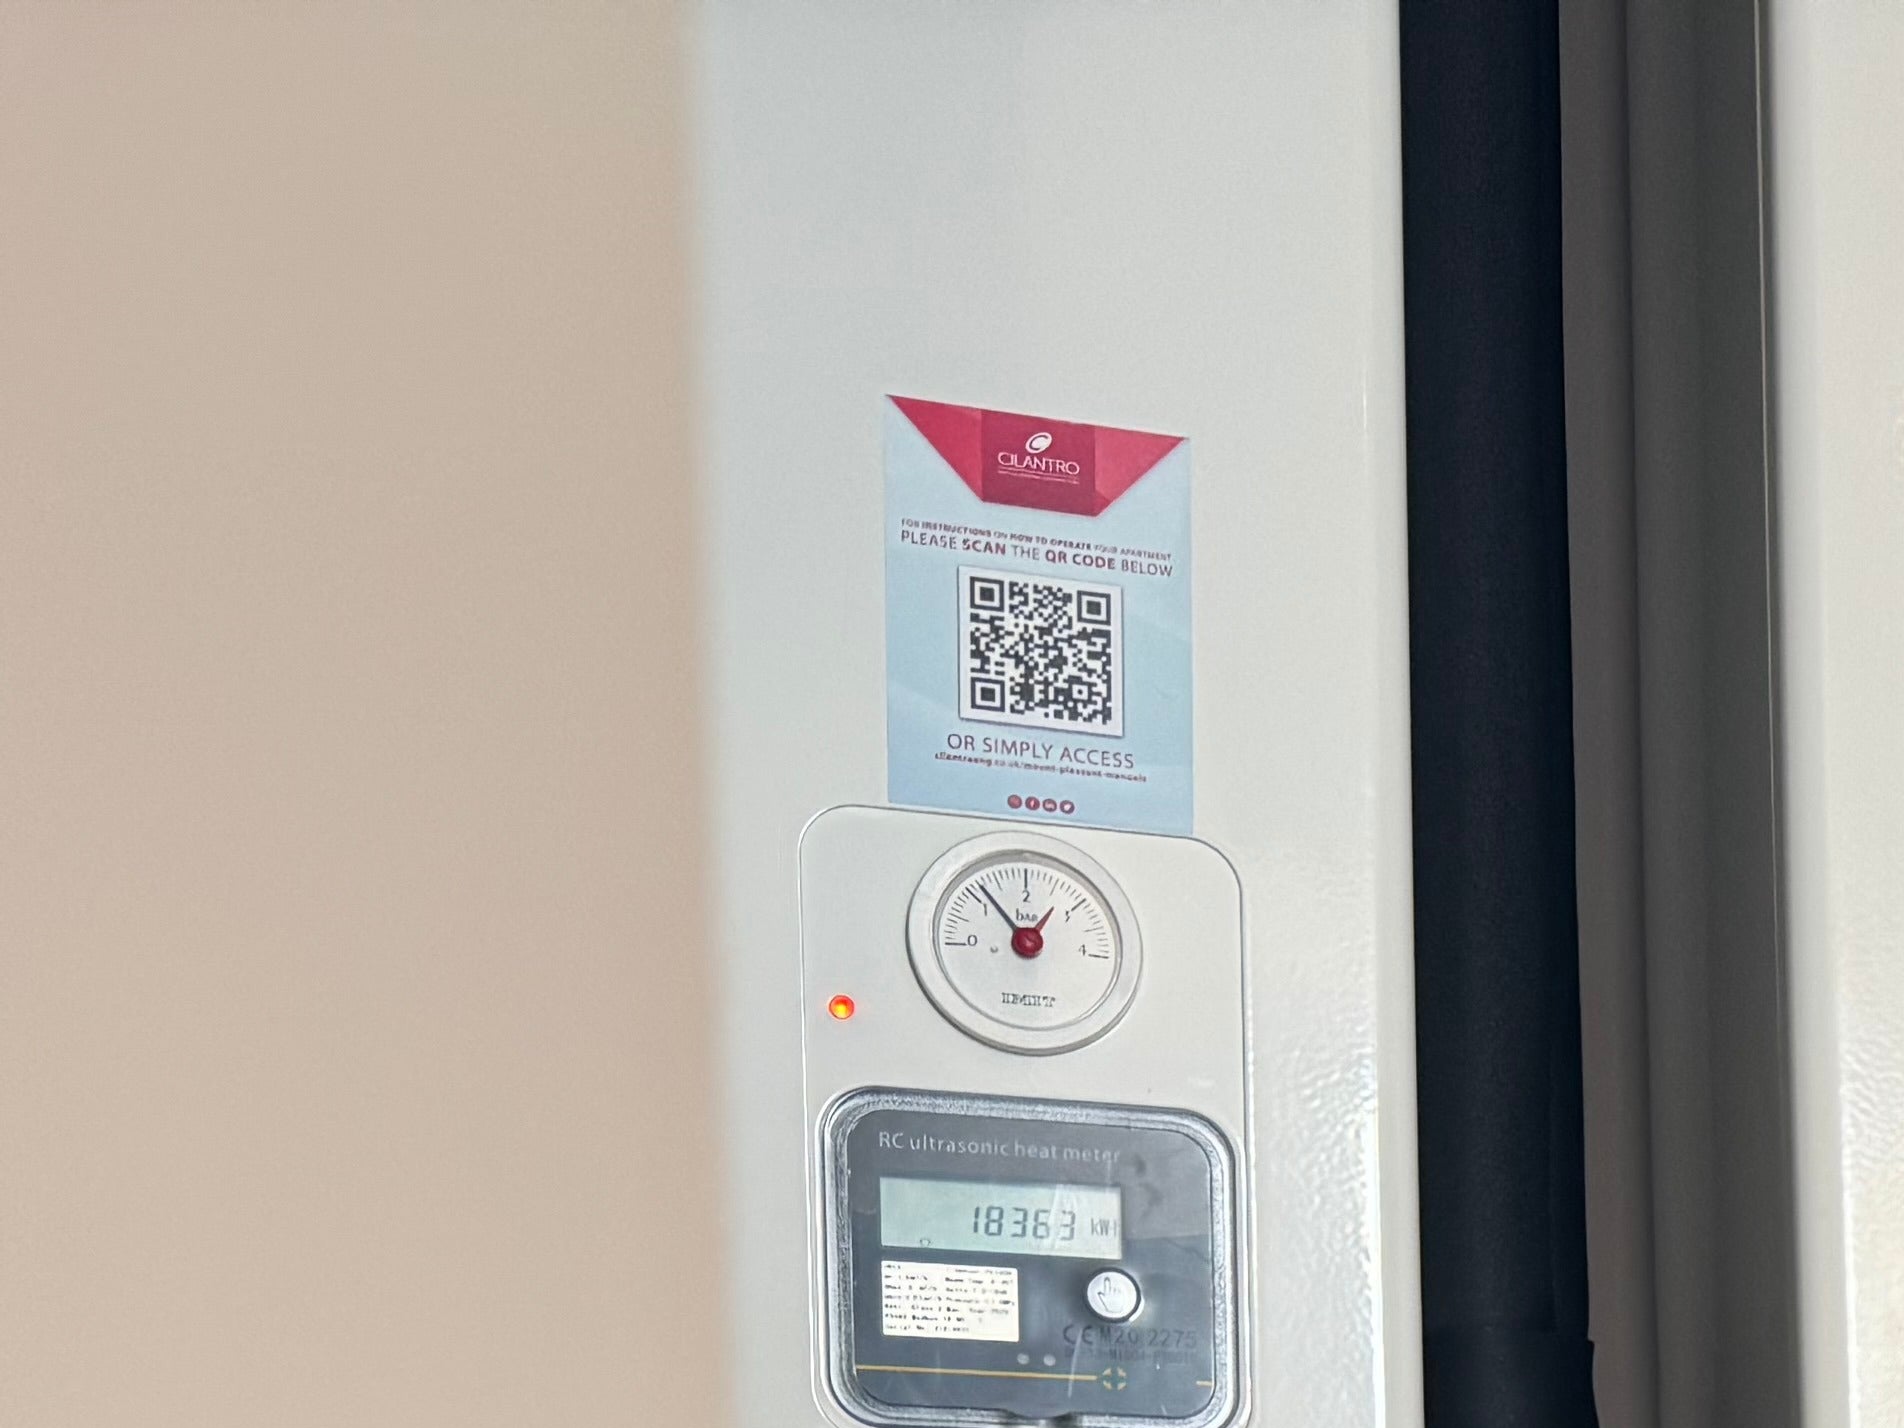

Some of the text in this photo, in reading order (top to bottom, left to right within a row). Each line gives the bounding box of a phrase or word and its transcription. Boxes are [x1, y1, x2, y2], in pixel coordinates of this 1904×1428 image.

[997, 452, 1080, 475] CILANTRO
[901, 530, 1173, 577] PLEASE SCAN THE QR CODE BELOW
[921, 520, 991, 538] INSTRUCTIONS
[1010, 533, 1033, 544] HOW
[1036, 535, 1047, 545] TO
[1050, 538, 1092, 550] OPERATE
[1119, 547, 1171, 561] APARTMENT
[947, 734, 1134, 769] OR SIMPLY ACCESS
[1022, 890, 1030, 903] 2
[967, 935, 977, 946] 0
[1078, 944, 1087, 956] 4
[879, 1131, 1121, 1163] RC ultrasonic heat meter
[972, 1205, 1076, 1241] 18363
[1145, 1329, 1197, 1347] 2275
